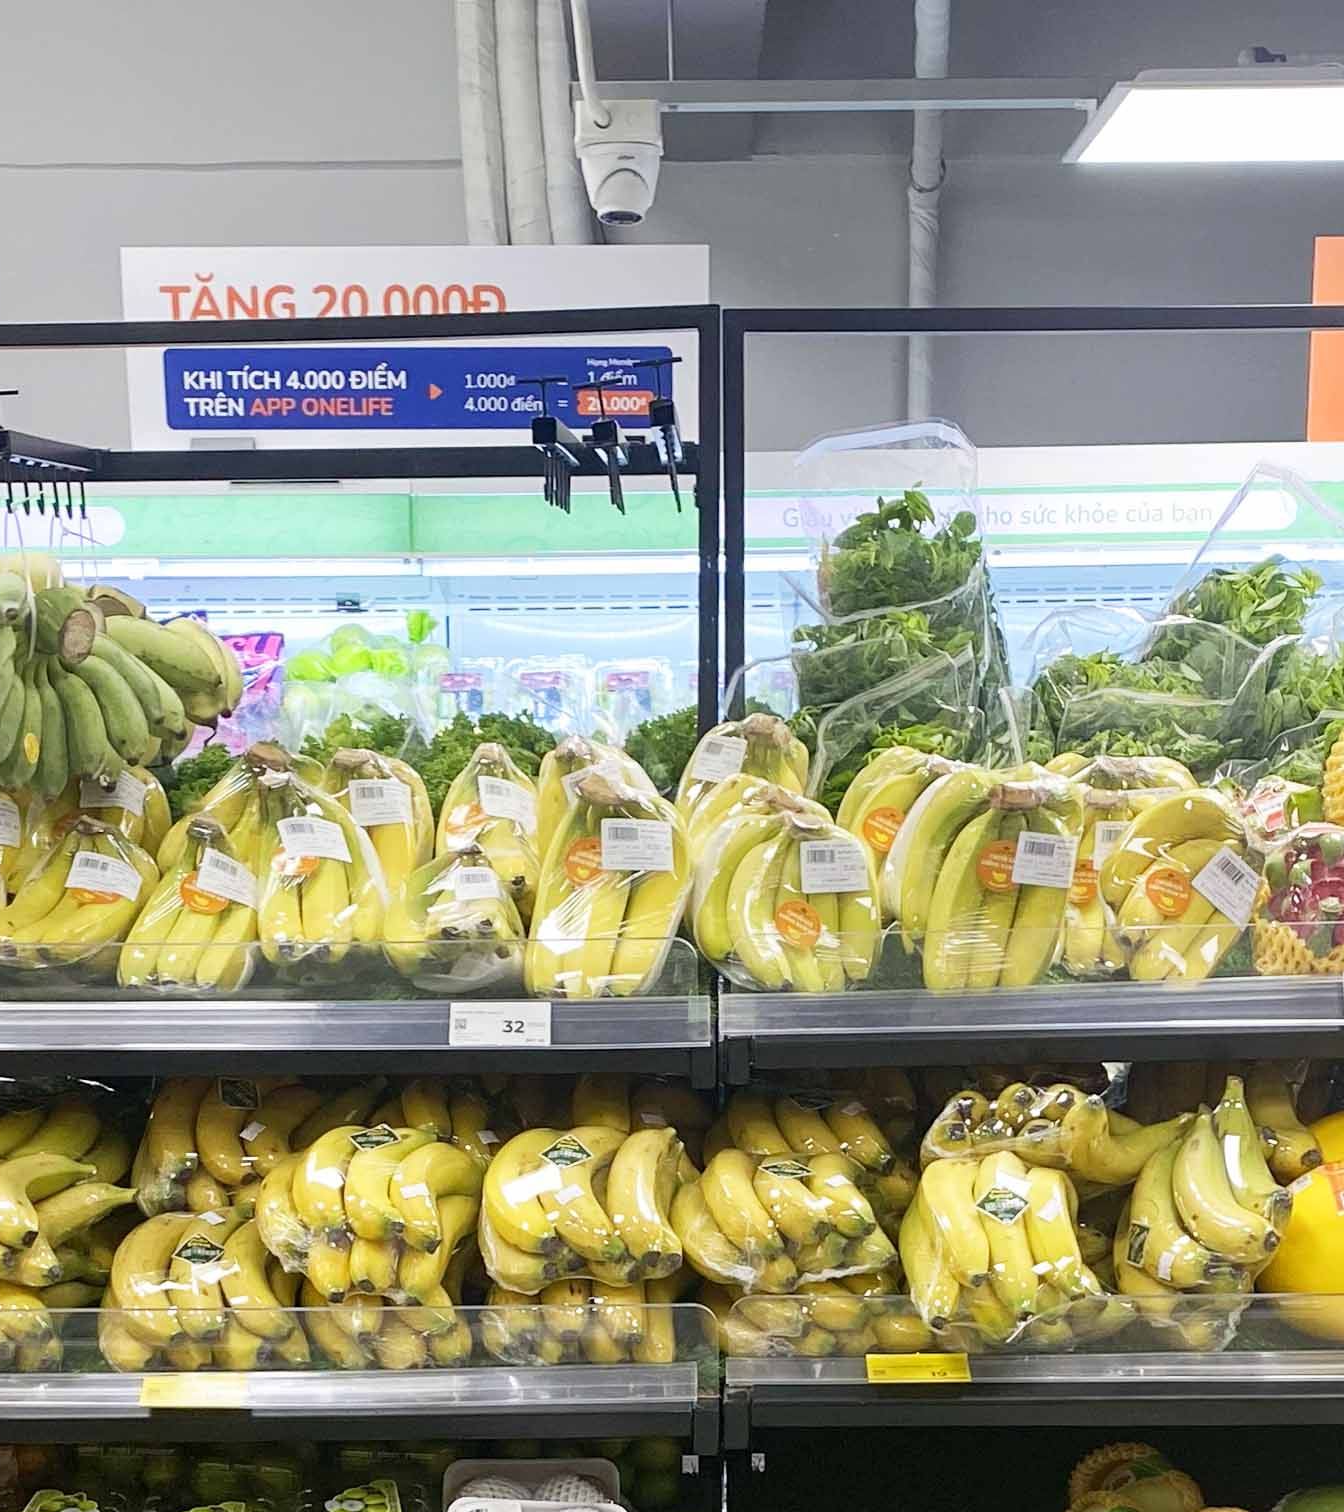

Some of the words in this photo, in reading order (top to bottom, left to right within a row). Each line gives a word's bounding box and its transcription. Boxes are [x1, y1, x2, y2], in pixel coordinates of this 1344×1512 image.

[183, 371, 222, 390] KHI
[227, 364, 281, 390] TÍCH
[286, 370, 345, 390] 4.000
[349, 362, 407, 390] ĐIỂM
[184, 392, 245, 417] TRÊN
[250, 398, 296, 416] APP
[302, 398, 393, 416] ONELIFE
[464, 397, 508, 411] 4.000
[502, 1020, 525, 1033] 32
